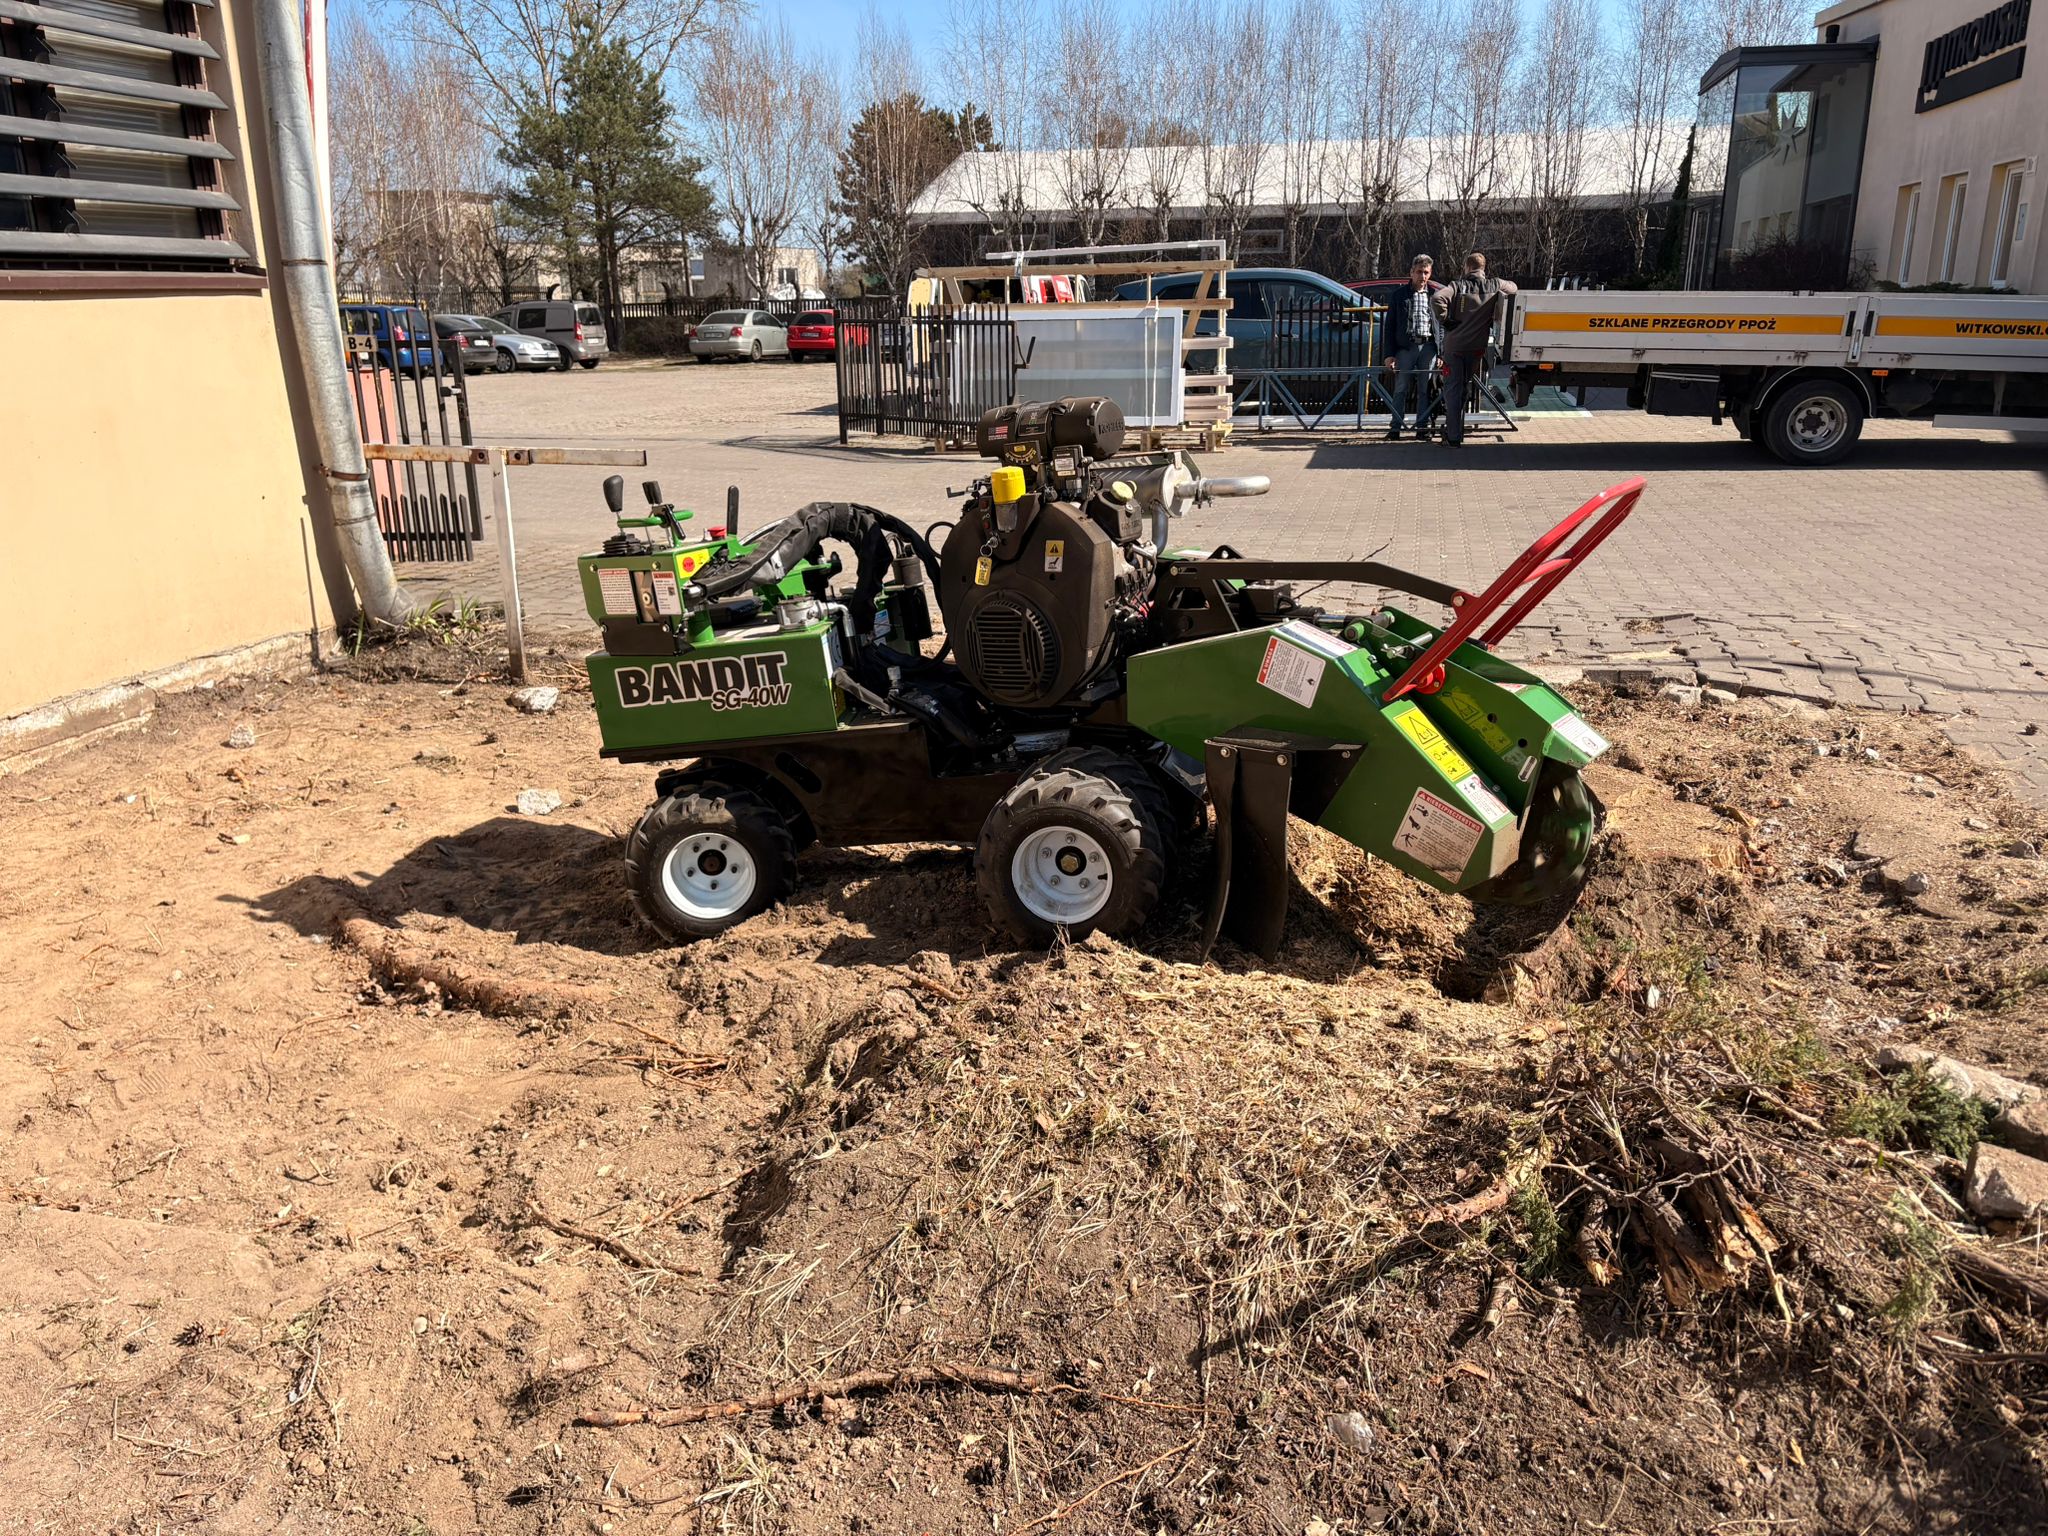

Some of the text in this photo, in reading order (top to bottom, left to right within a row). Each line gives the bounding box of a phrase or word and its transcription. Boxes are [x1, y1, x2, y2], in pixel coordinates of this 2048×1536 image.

[1588, 318, 1777, 330] SZKLANE PRZEGRODY PPOŻ
[348, 336, 372, 350] B-4
[616, 652, 786, 706] BANDIT
[712, 685, 791, 710] SG-40W
